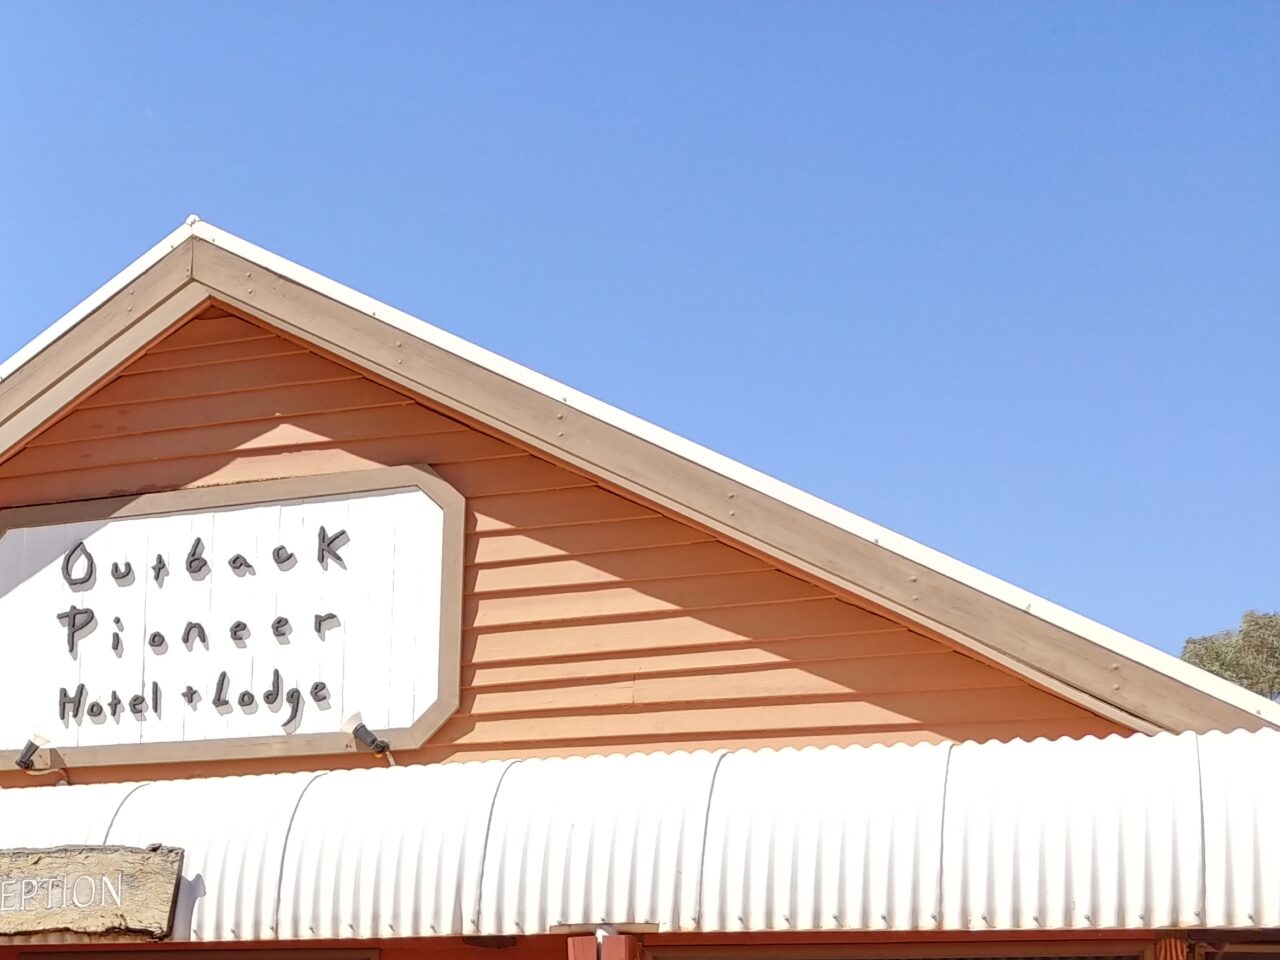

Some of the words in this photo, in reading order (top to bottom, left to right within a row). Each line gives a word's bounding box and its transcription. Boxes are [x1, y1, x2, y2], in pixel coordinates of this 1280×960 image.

[57, 605, 341, 657] Pioneer
[59, 681, 162, 724] Hotel
[212, 669, 331, 731] Lodge
